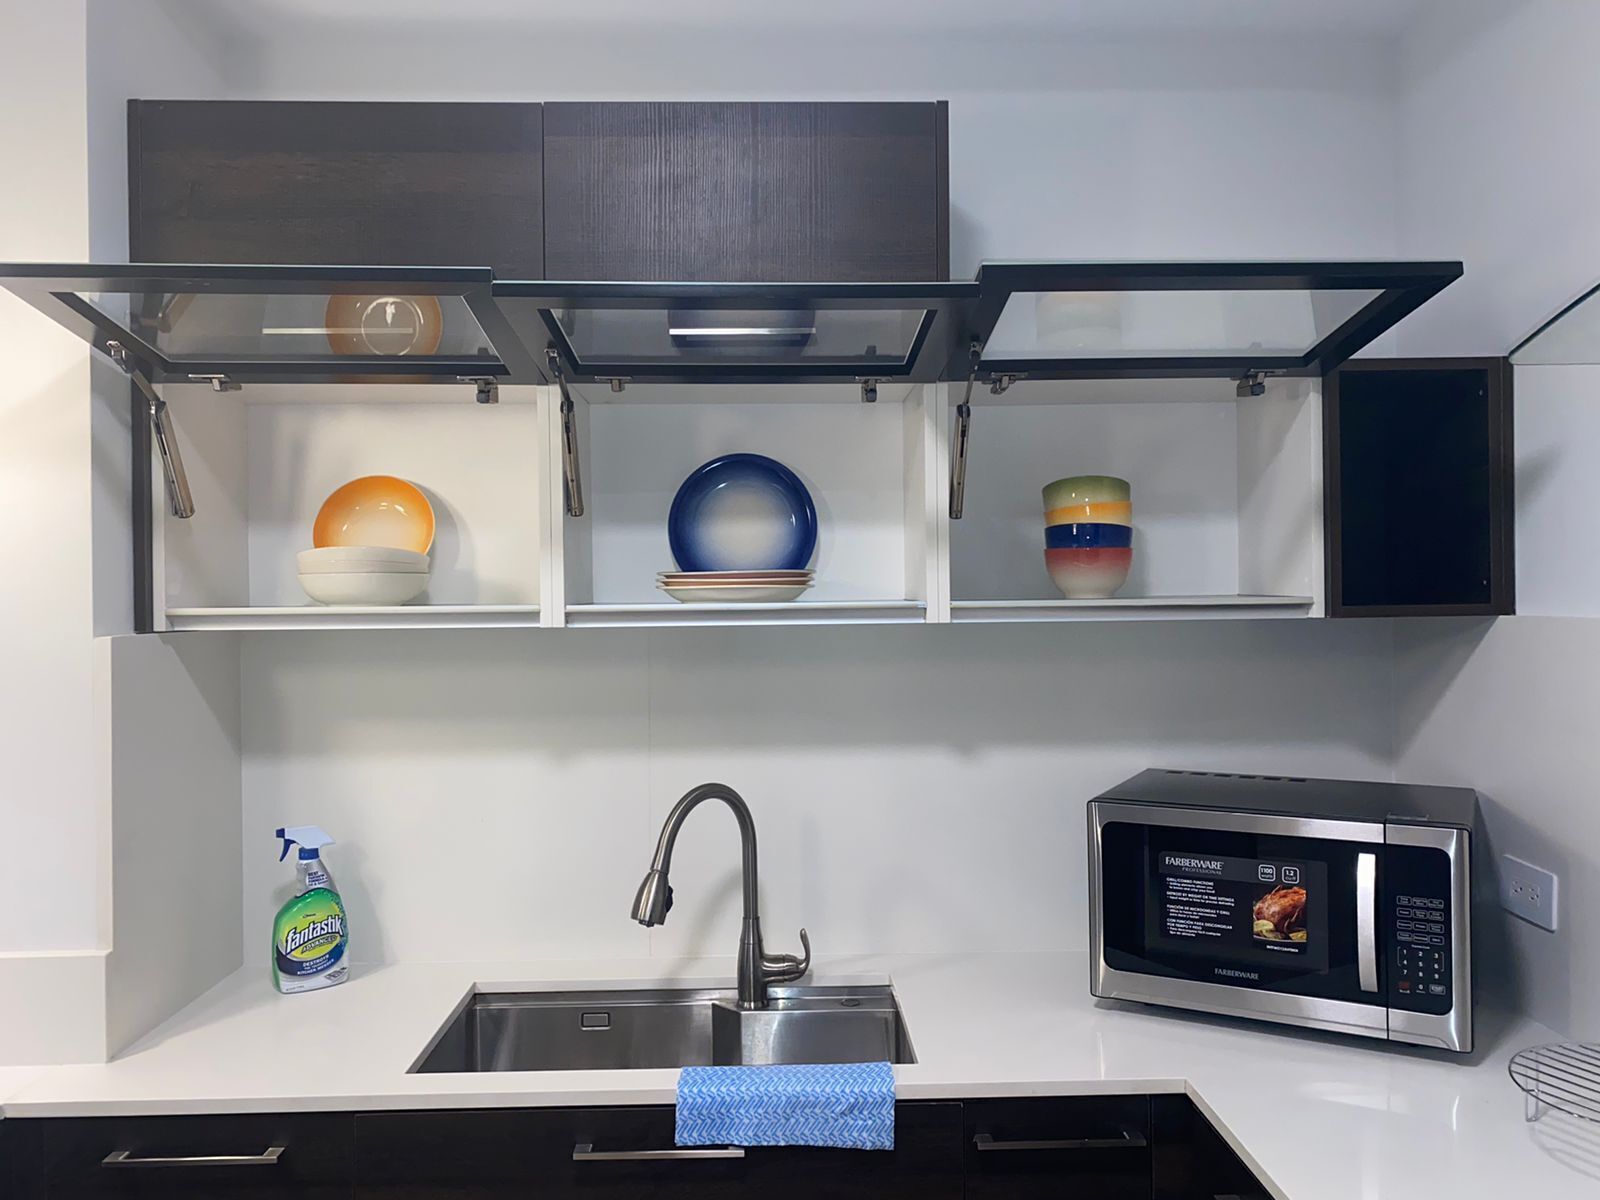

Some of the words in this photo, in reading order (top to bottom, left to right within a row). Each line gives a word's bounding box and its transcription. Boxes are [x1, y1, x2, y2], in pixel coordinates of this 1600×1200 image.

[1165, 856, 1224, 870] FARBERWARE
[286, 915, 343, 954] fantastik
[301, 935, 337, 954] ADVANCED
[303, 954, 329, 967] DESTROYS
[1214, 968, 1259, 980] FARBERWARE
